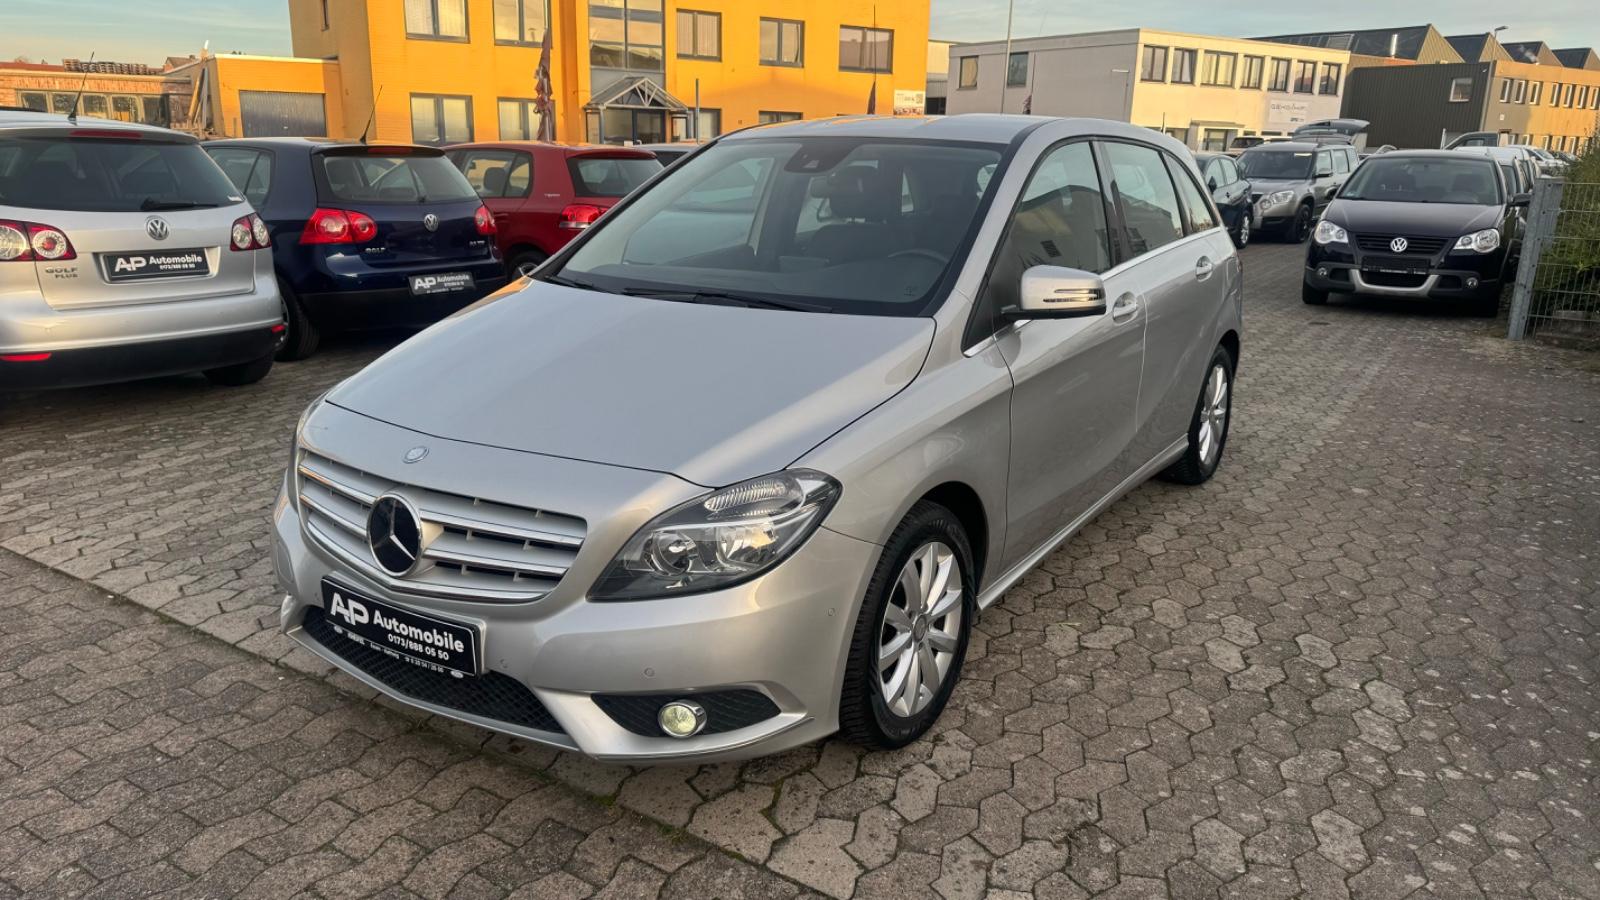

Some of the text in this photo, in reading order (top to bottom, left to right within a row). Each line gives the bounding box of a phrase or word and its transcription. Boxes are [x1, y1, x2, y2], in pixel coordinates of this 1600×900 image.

[114, 253, 203, 272] AP Automobile
[414, 276, 437, 290] AP
[330, 592, 369, 626] AP
[373, 610, 464, 653] Automobile
[387, 633, 424, 653] 0173/888
[425, 647, 437, 657] 05
[437, 650, 450, 660] 50
